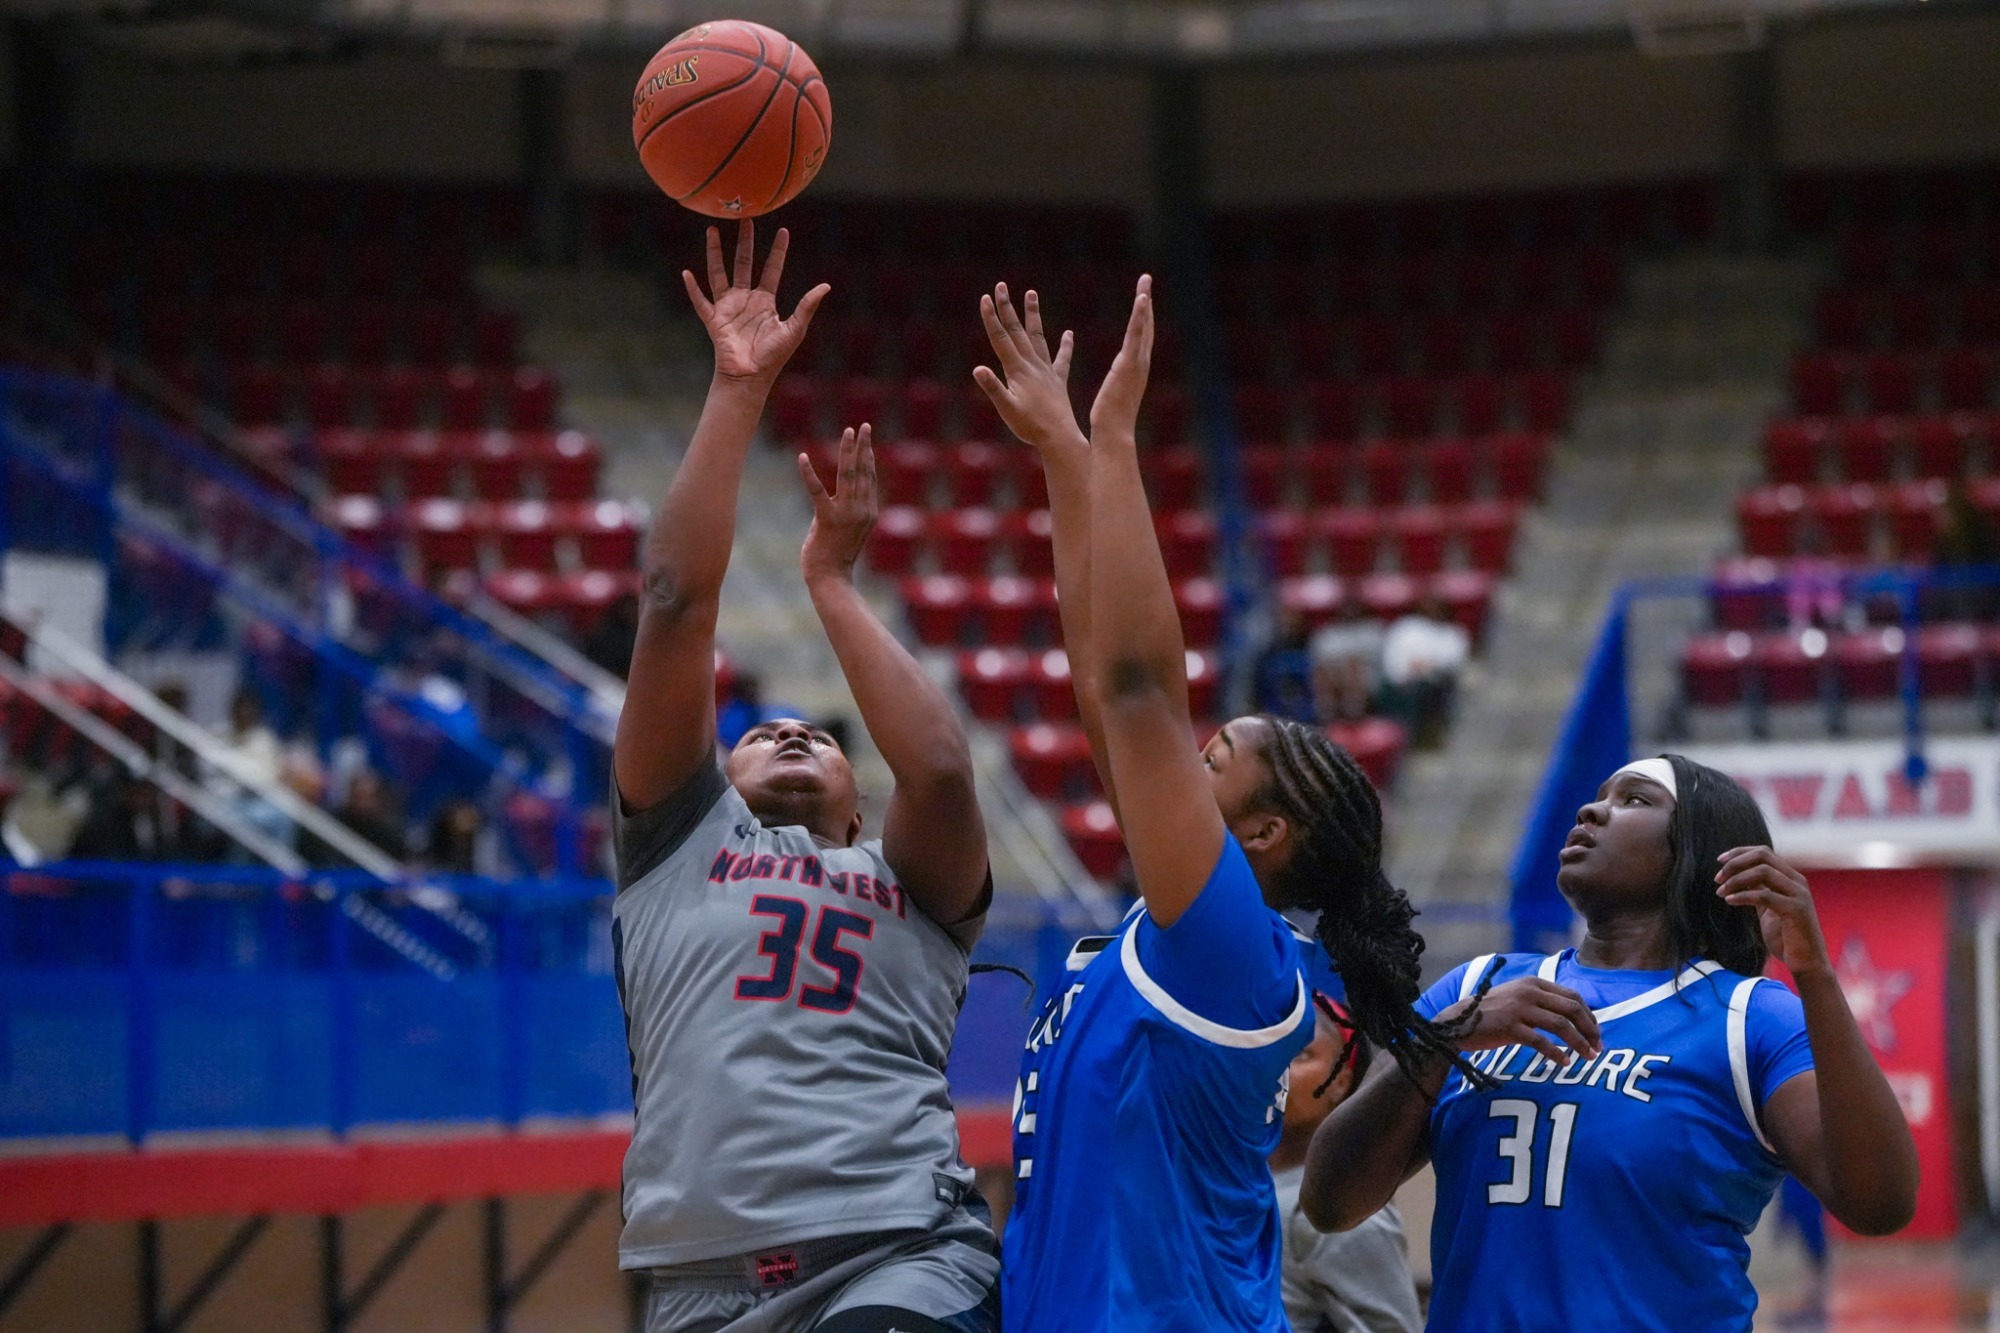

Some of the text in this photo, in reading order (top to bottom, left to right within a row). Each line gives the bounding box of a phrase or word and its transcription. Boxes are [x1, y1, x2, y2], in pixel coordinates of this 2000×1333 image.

[707, 848, 906, 920] NORTHWEST
[733, 893, 874, 1015] 35
[1487, 1099, 1578, 1208] 31
